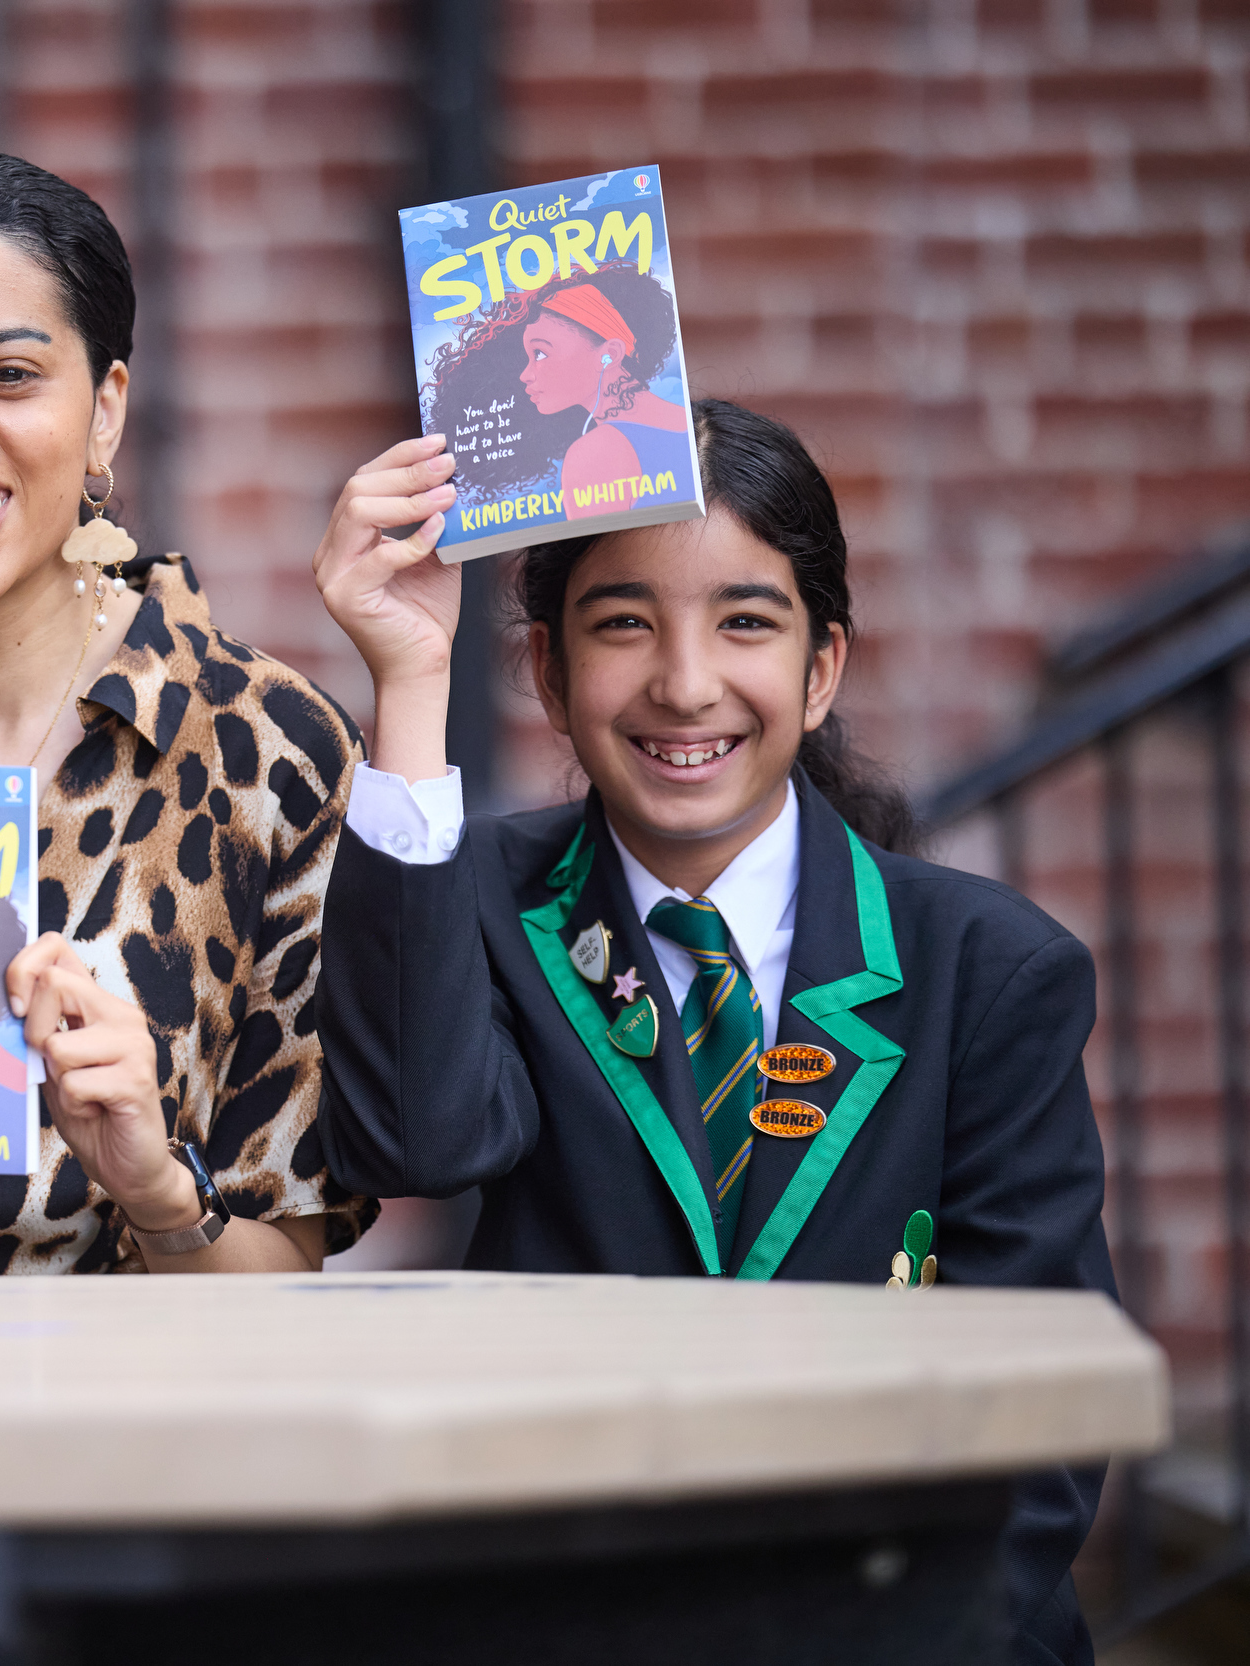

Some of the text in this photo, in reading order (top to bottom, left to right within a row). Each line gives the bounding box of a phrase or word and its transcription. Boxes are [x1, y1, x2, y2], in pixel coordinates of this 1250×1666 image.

[489, 194, 571, 230] Quiet
[419, 210, 653, 322] STORM
[463, 395, 515, 422] You don't
[456, 414, 510, 437] have to be
[455, 432, 522, 453] loud to have
[473, 449, 515, 464] a voice
[461, 470, 677, 531] KIMBERLY WHITTAM
[581, 946, 600, 969] HELP
[615, 1008, 649, 1042] SPORTS
[768, 1056, 825, 1073] BRONZE
[760, 1110, 816, 1128] BRONZE
